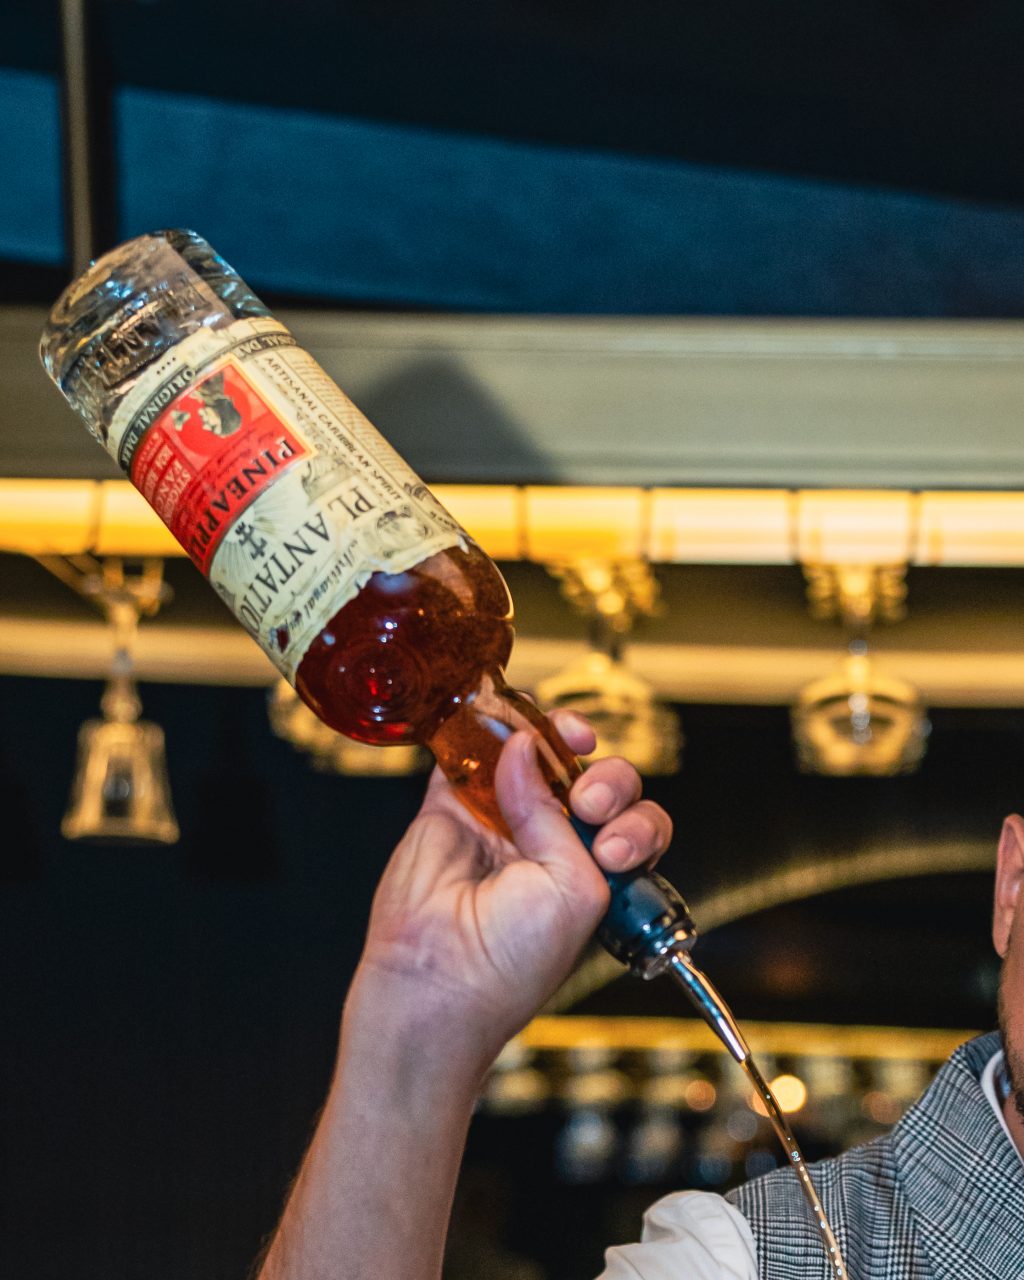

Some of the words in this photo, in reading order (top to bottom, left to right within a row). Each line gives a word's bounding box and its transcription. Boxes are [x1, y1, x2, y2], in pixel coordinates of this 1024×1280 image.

[135, 366, 196, 432] ORIGINAL
[264, 355, 316, 411] ARTISANAL
[120, 430, 139, 465] DARK
[152, 458, 183, 512] FANC
[238, 484, 376, 635] PLANTATIO
